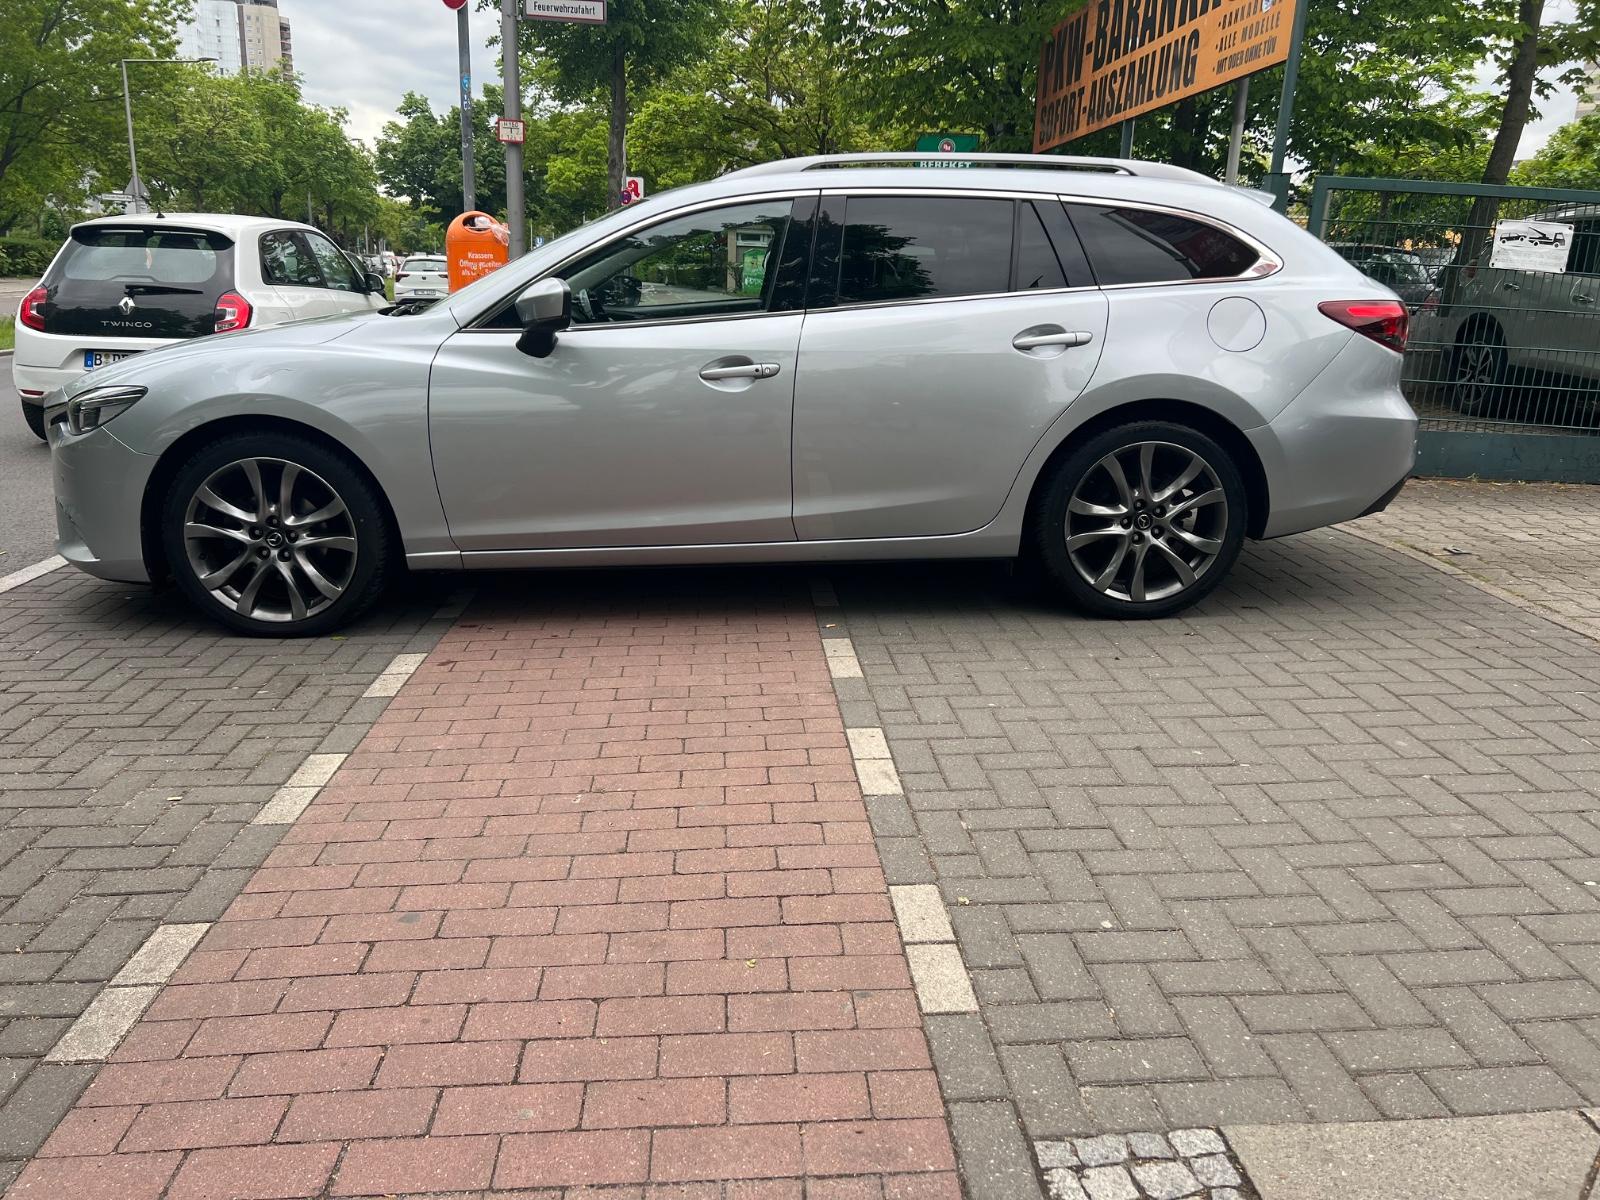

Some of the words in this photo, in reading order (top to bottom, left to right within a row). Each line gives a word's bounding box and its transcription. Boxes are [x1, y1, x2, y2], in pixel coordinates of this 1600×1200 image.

[533, 1, 596, 15] Feuerwehrzufahrt
[1219, 31, 1237, 53] ALLE
[1241, 11, 1281, 43] MODELLE
[1228, 50, 1244, 70] ODER
[1039, 28, 1200, 146] SOFORT-AUSZAHLUNG
[101, 320, 153, 328] TWINGO
[94, 354, 103, 366] B
